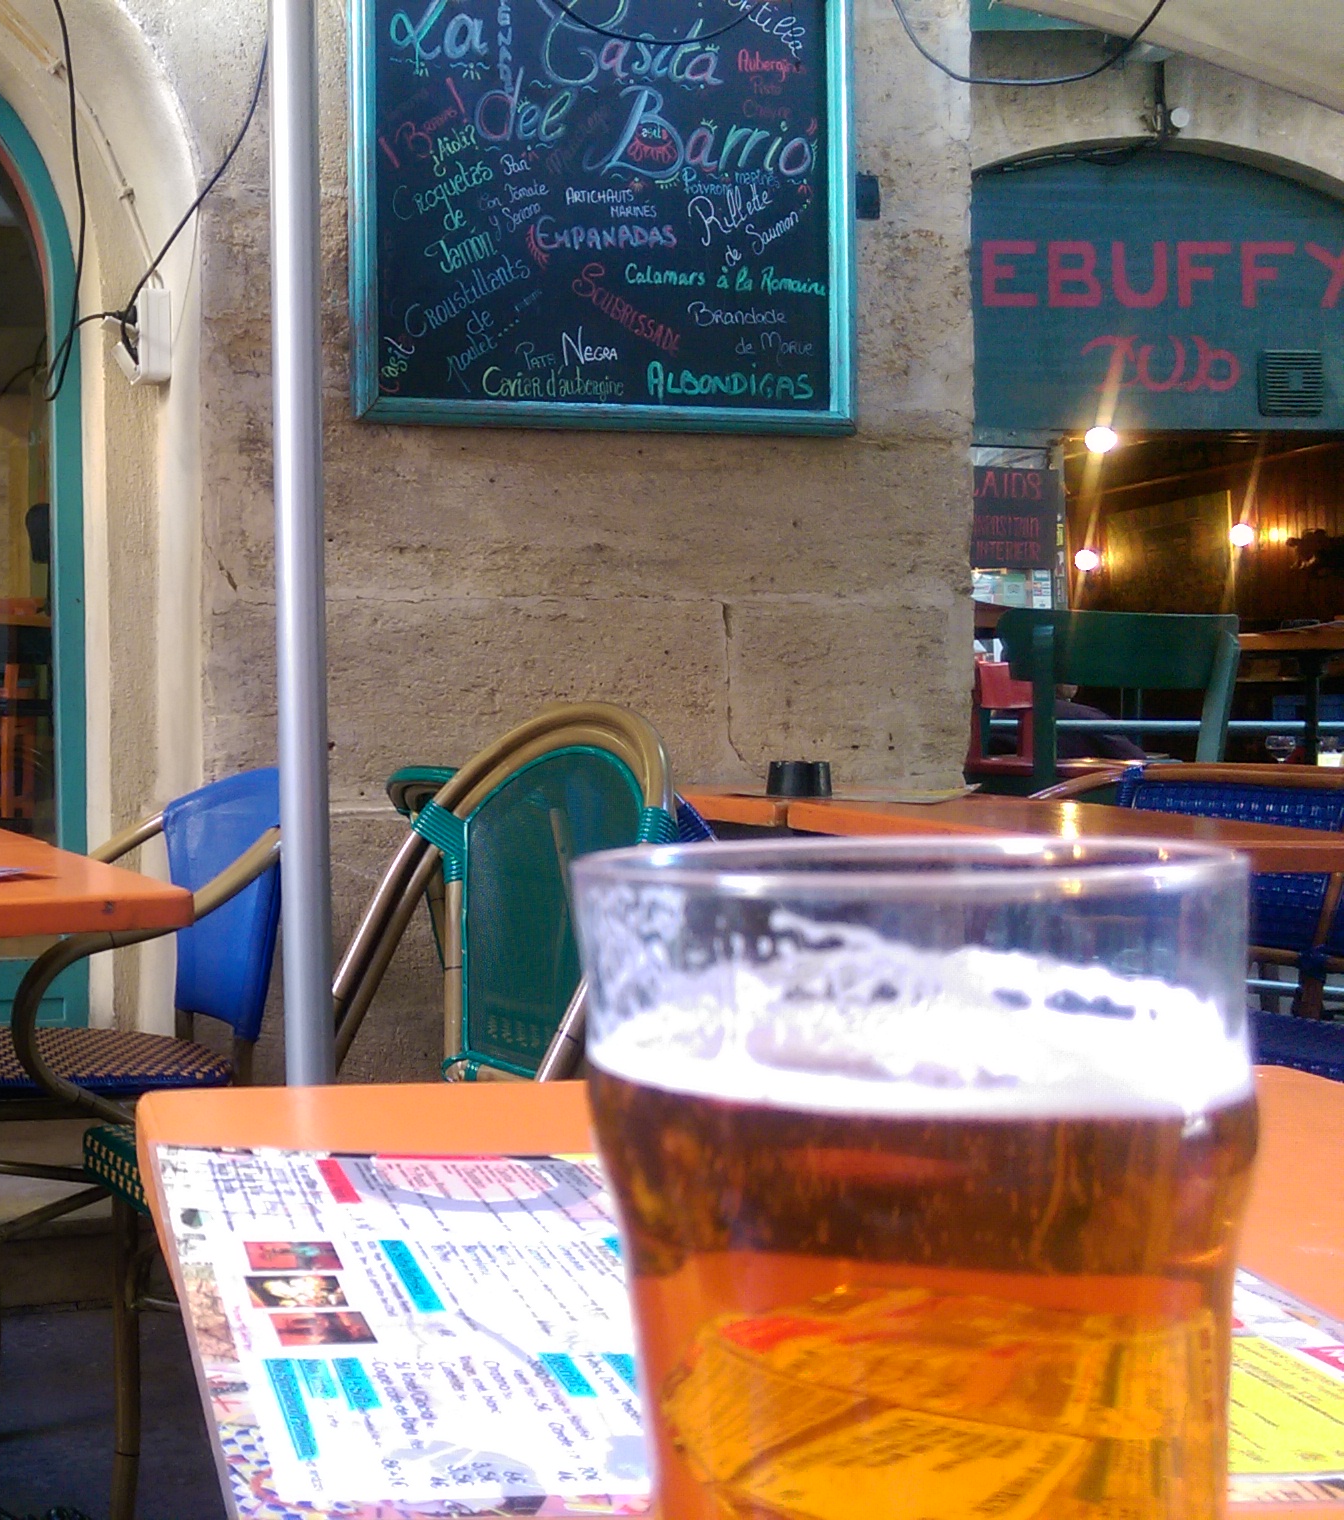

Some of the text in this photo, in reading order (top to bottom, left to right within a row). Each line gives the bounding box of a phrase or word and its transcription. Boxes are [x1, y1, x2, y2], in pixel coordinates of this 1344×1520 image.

[390, 0, 488, 60] La
[475, 66, 576, 141] del
[582, 86, 813, 178] Barrio
[725, 245, 742, 267] de
[467, 310, 494, 335] de
